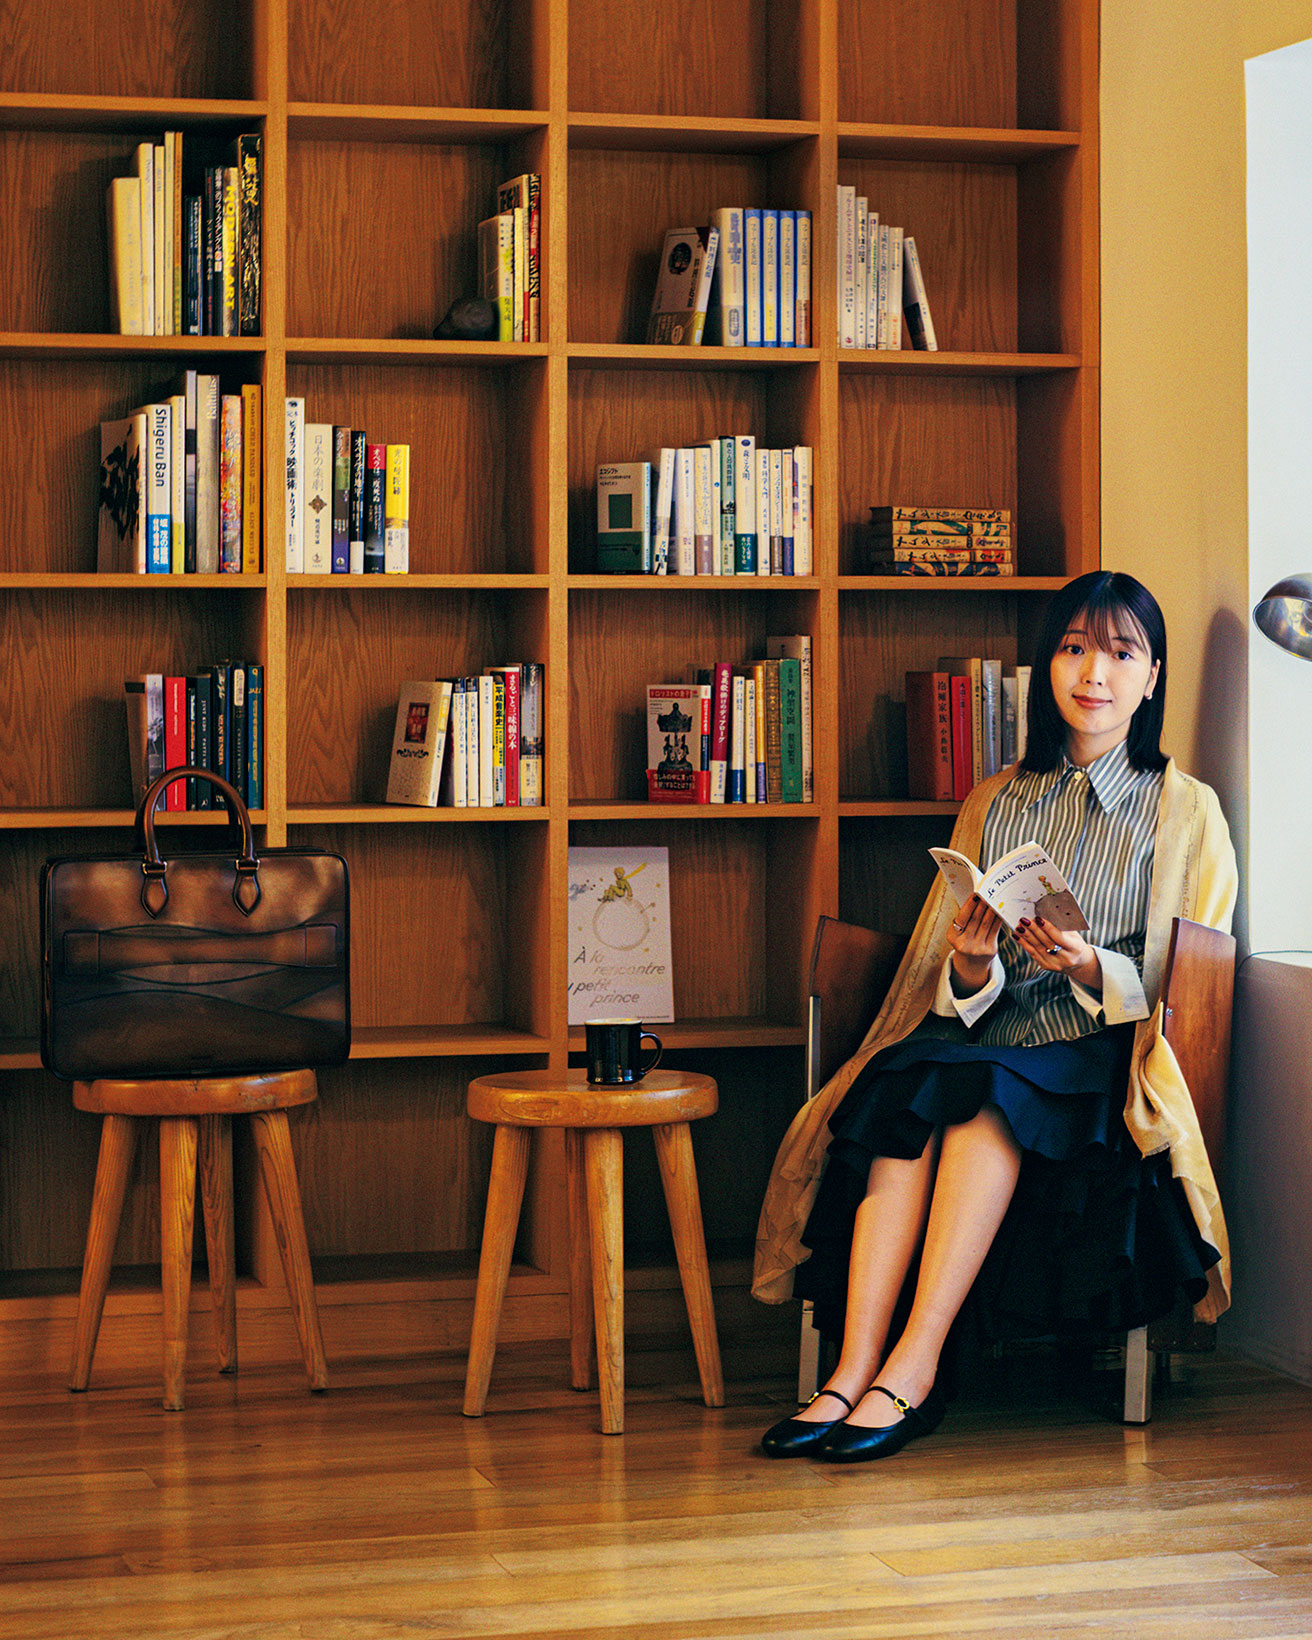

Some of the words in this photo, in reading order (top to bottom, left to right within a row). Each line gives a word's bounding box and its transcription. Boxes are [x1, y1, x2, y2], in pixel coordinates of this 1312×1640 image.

[225, 185, 236, 269] MODERN
[225, 276, 236, 310] ART
[153, 408, 167, 460] Shigeru
[155, 462, 165, 487] Ban
[994, 870, 1016, 886] Petit
[1015, 857, 1048, 872] Prince
[574, 946, 586, 964] À
[593, 962, 666, 976] rencontre
[573, 978, 612, 995] petit
[589, 991, 641, 1008] prince
